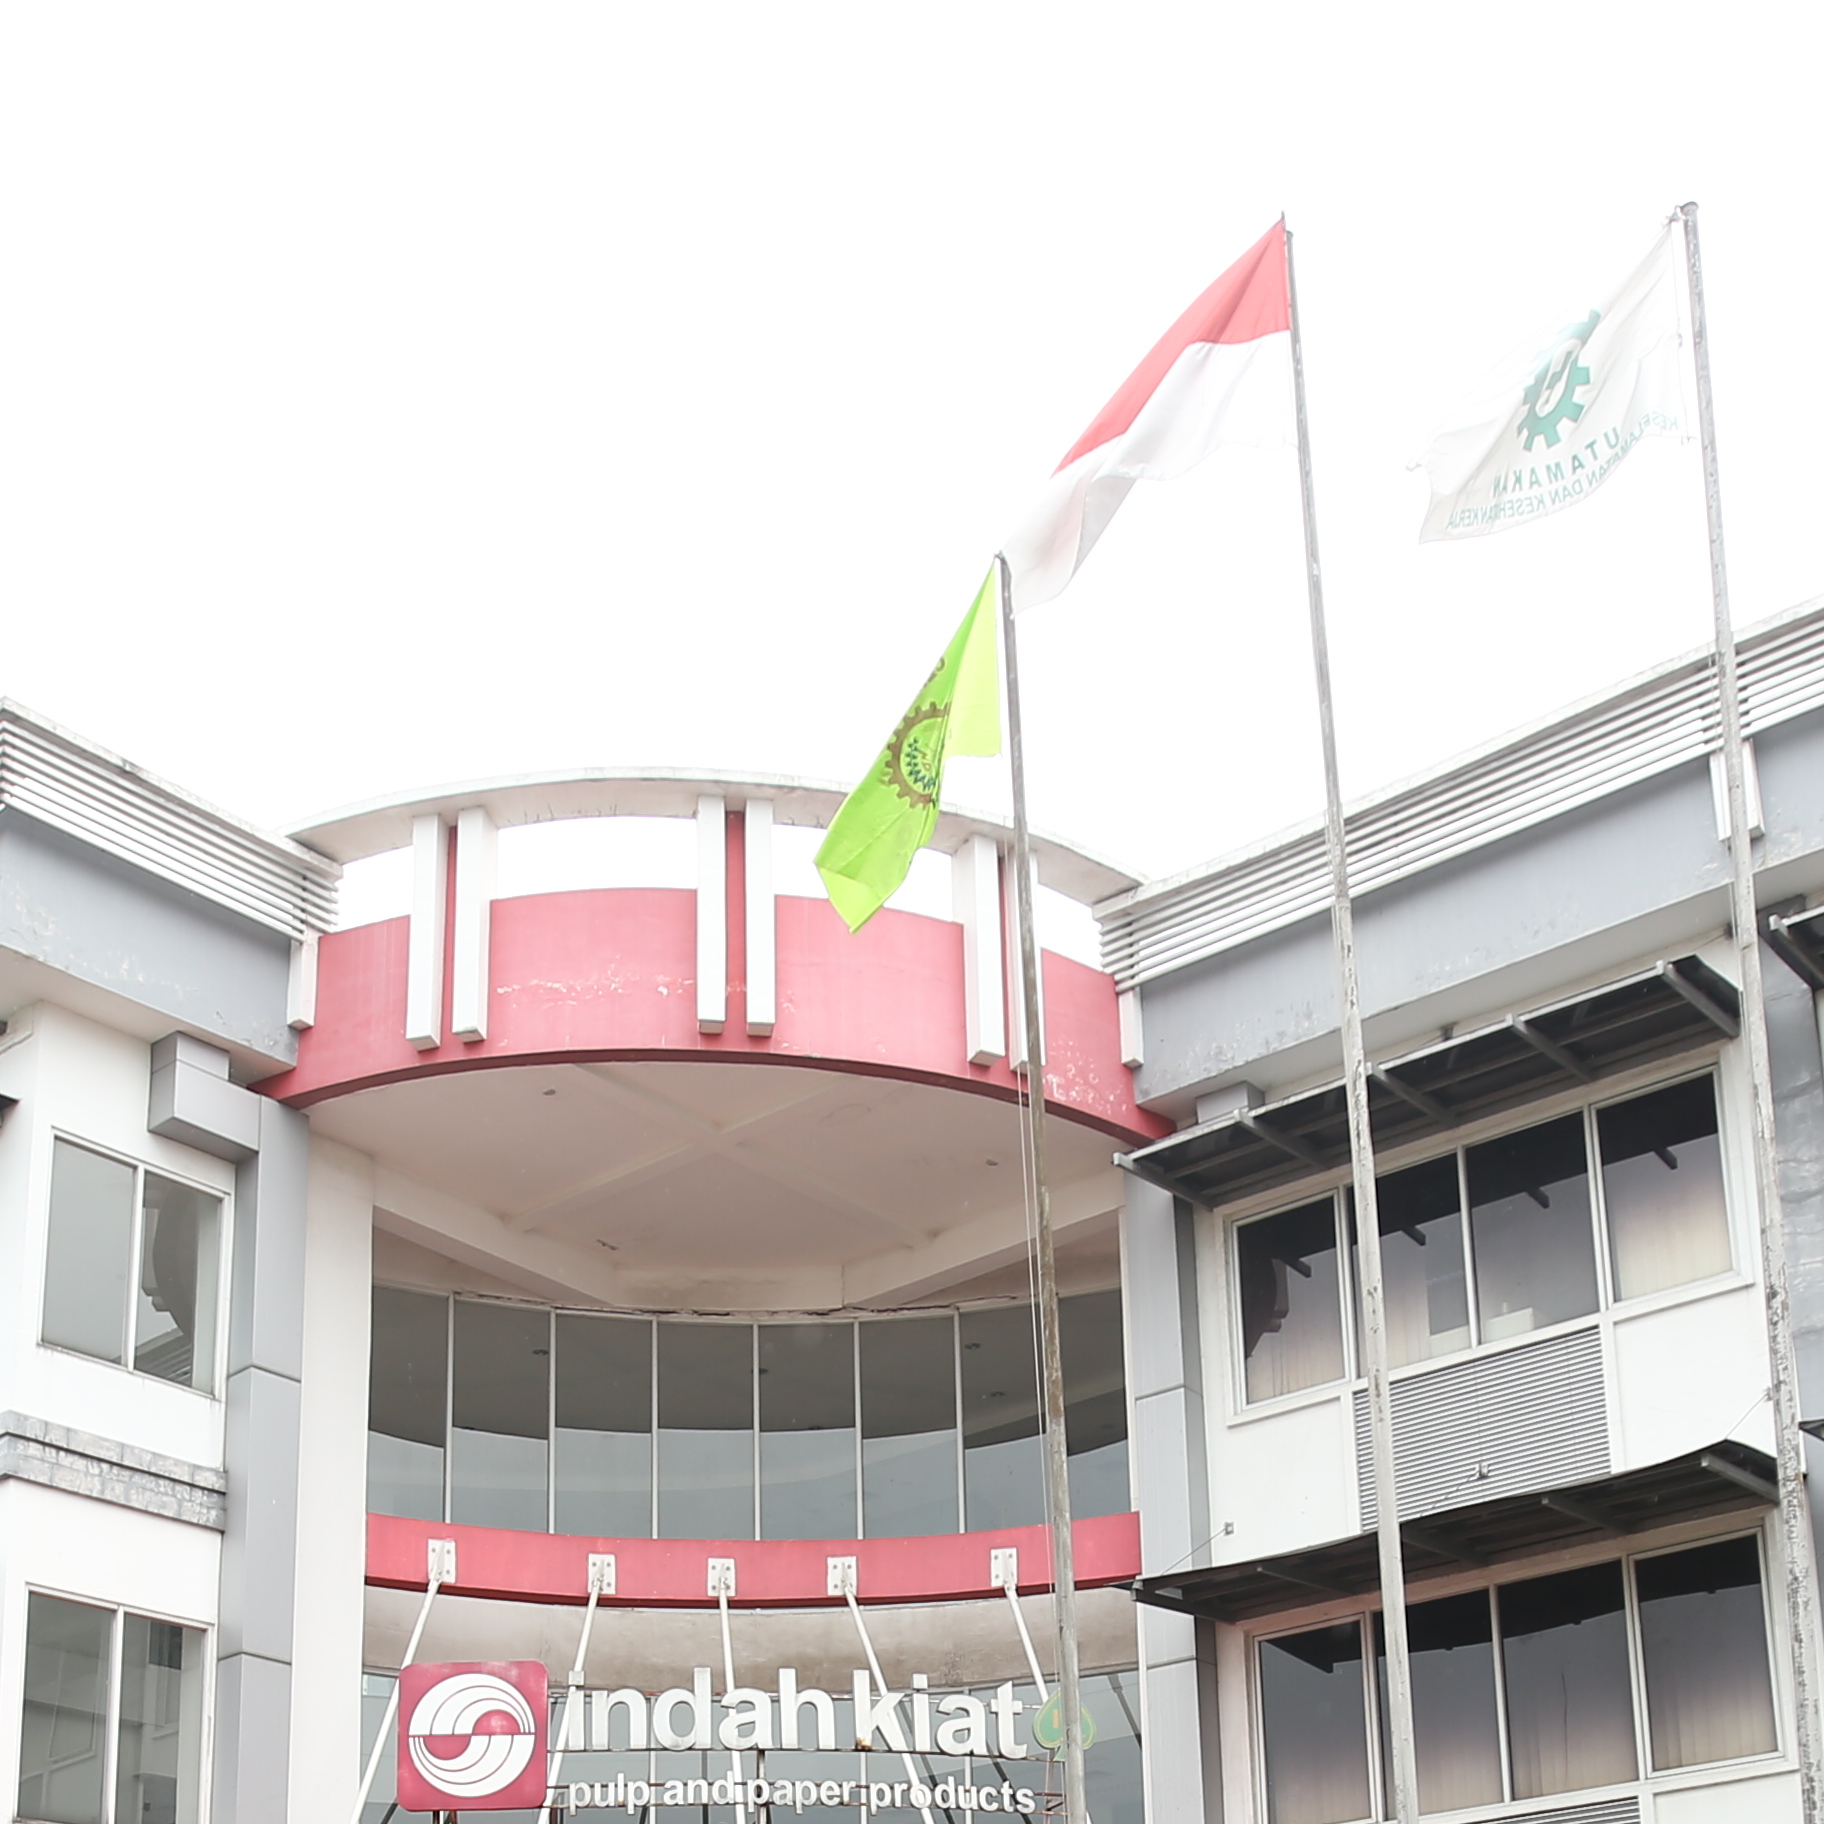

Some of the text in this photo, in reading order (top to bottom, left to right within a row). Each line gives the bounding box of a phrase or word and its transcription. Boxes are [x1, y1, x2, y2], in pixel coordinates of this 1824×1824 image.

[567, 1666, 1029, 1760] indah kiat
[569, 1769, 1037, 1817] pulp and paper products
